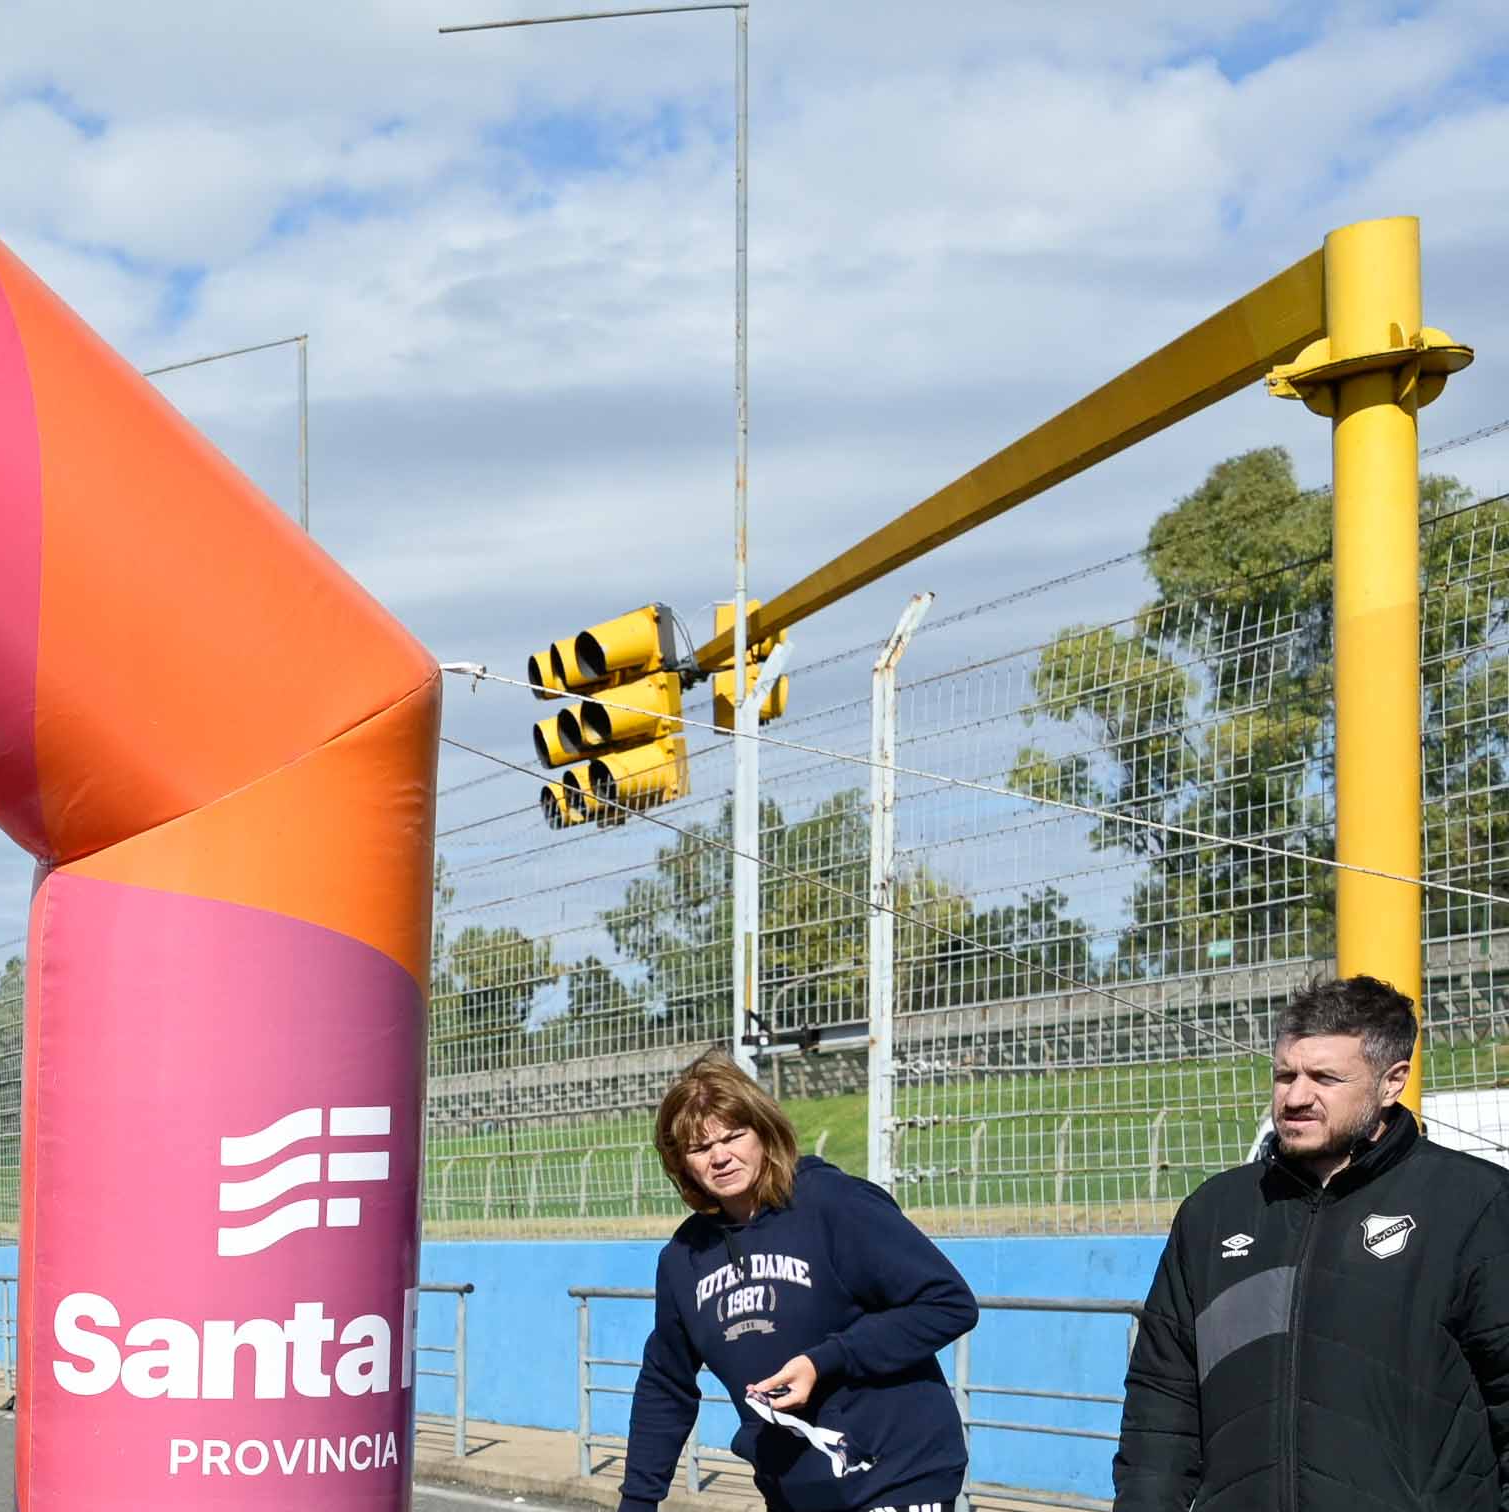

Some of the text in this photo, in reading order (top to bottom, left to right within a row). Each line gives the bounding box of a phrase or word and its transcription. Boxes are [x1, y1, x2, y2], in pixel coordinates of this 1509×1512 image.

[750, 1254, 813, 1288] DAME
[53, 1292, 391, 1400] Santa
[169, 1431, 398, 1477] PROVINCIA
